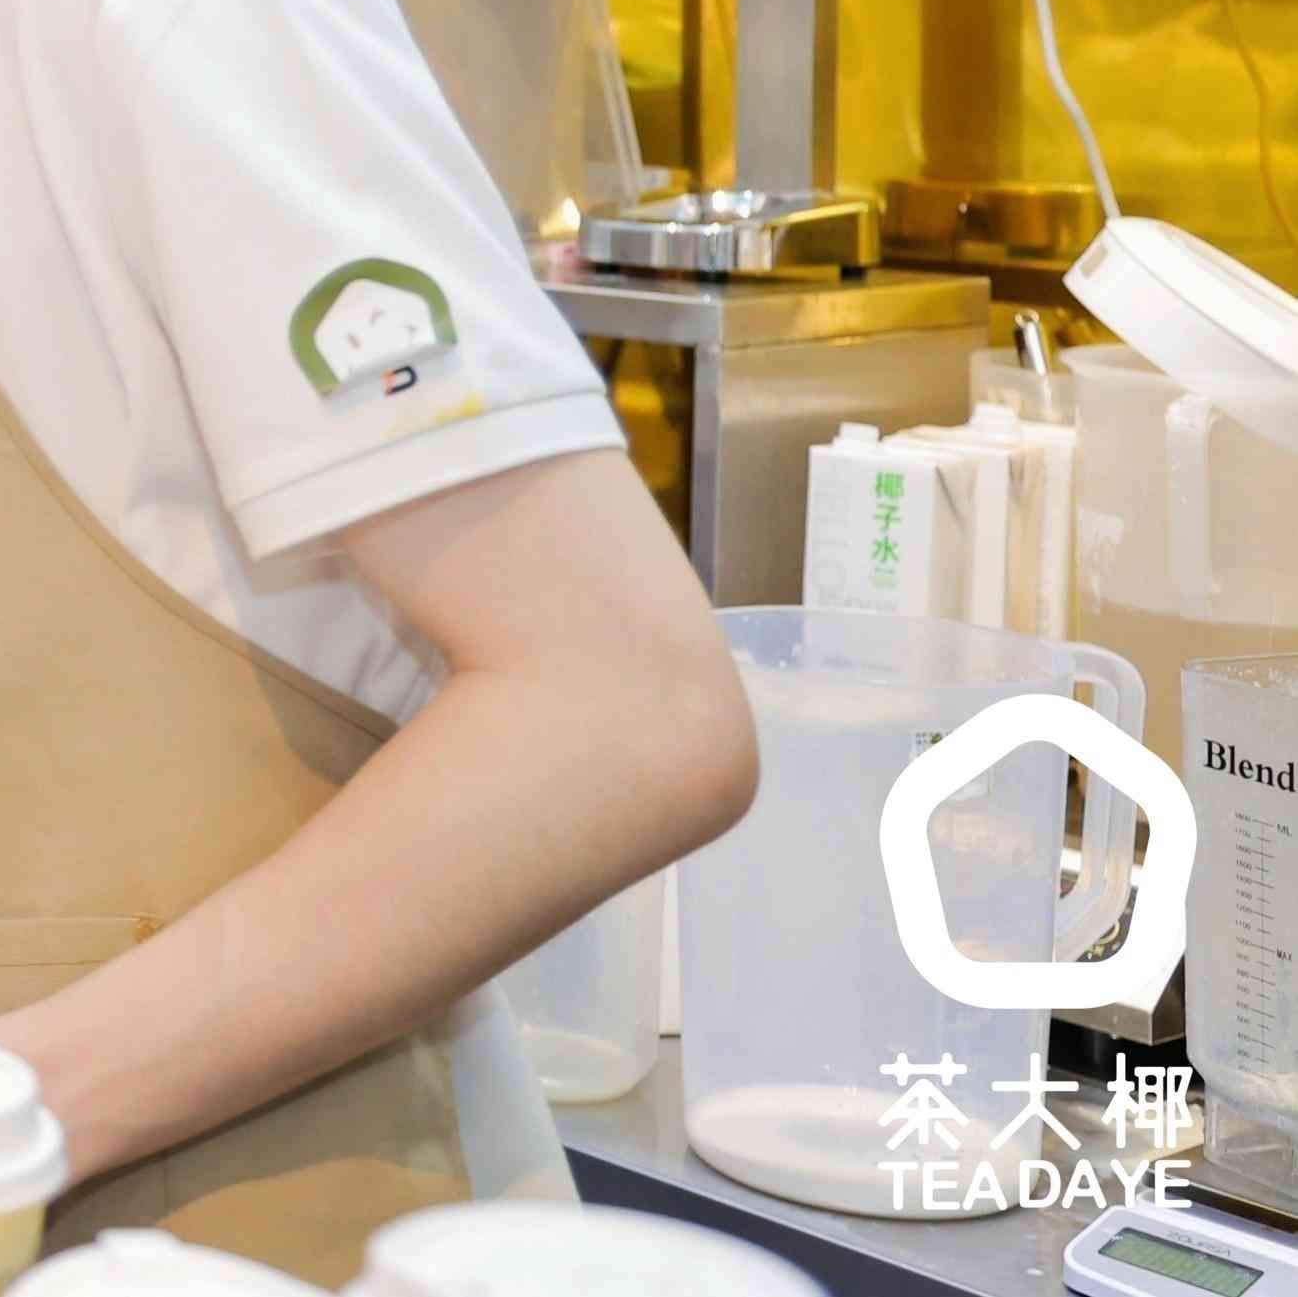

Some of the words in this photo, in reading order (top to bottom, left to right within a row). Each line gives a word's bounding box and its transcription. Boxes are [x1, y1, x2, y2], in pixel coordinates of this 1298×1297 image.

[871, 472, 904, 562] 椰子水
[1203, 738, 1297, 793] Blend
[1276, 945, 1293, 961] MAX
